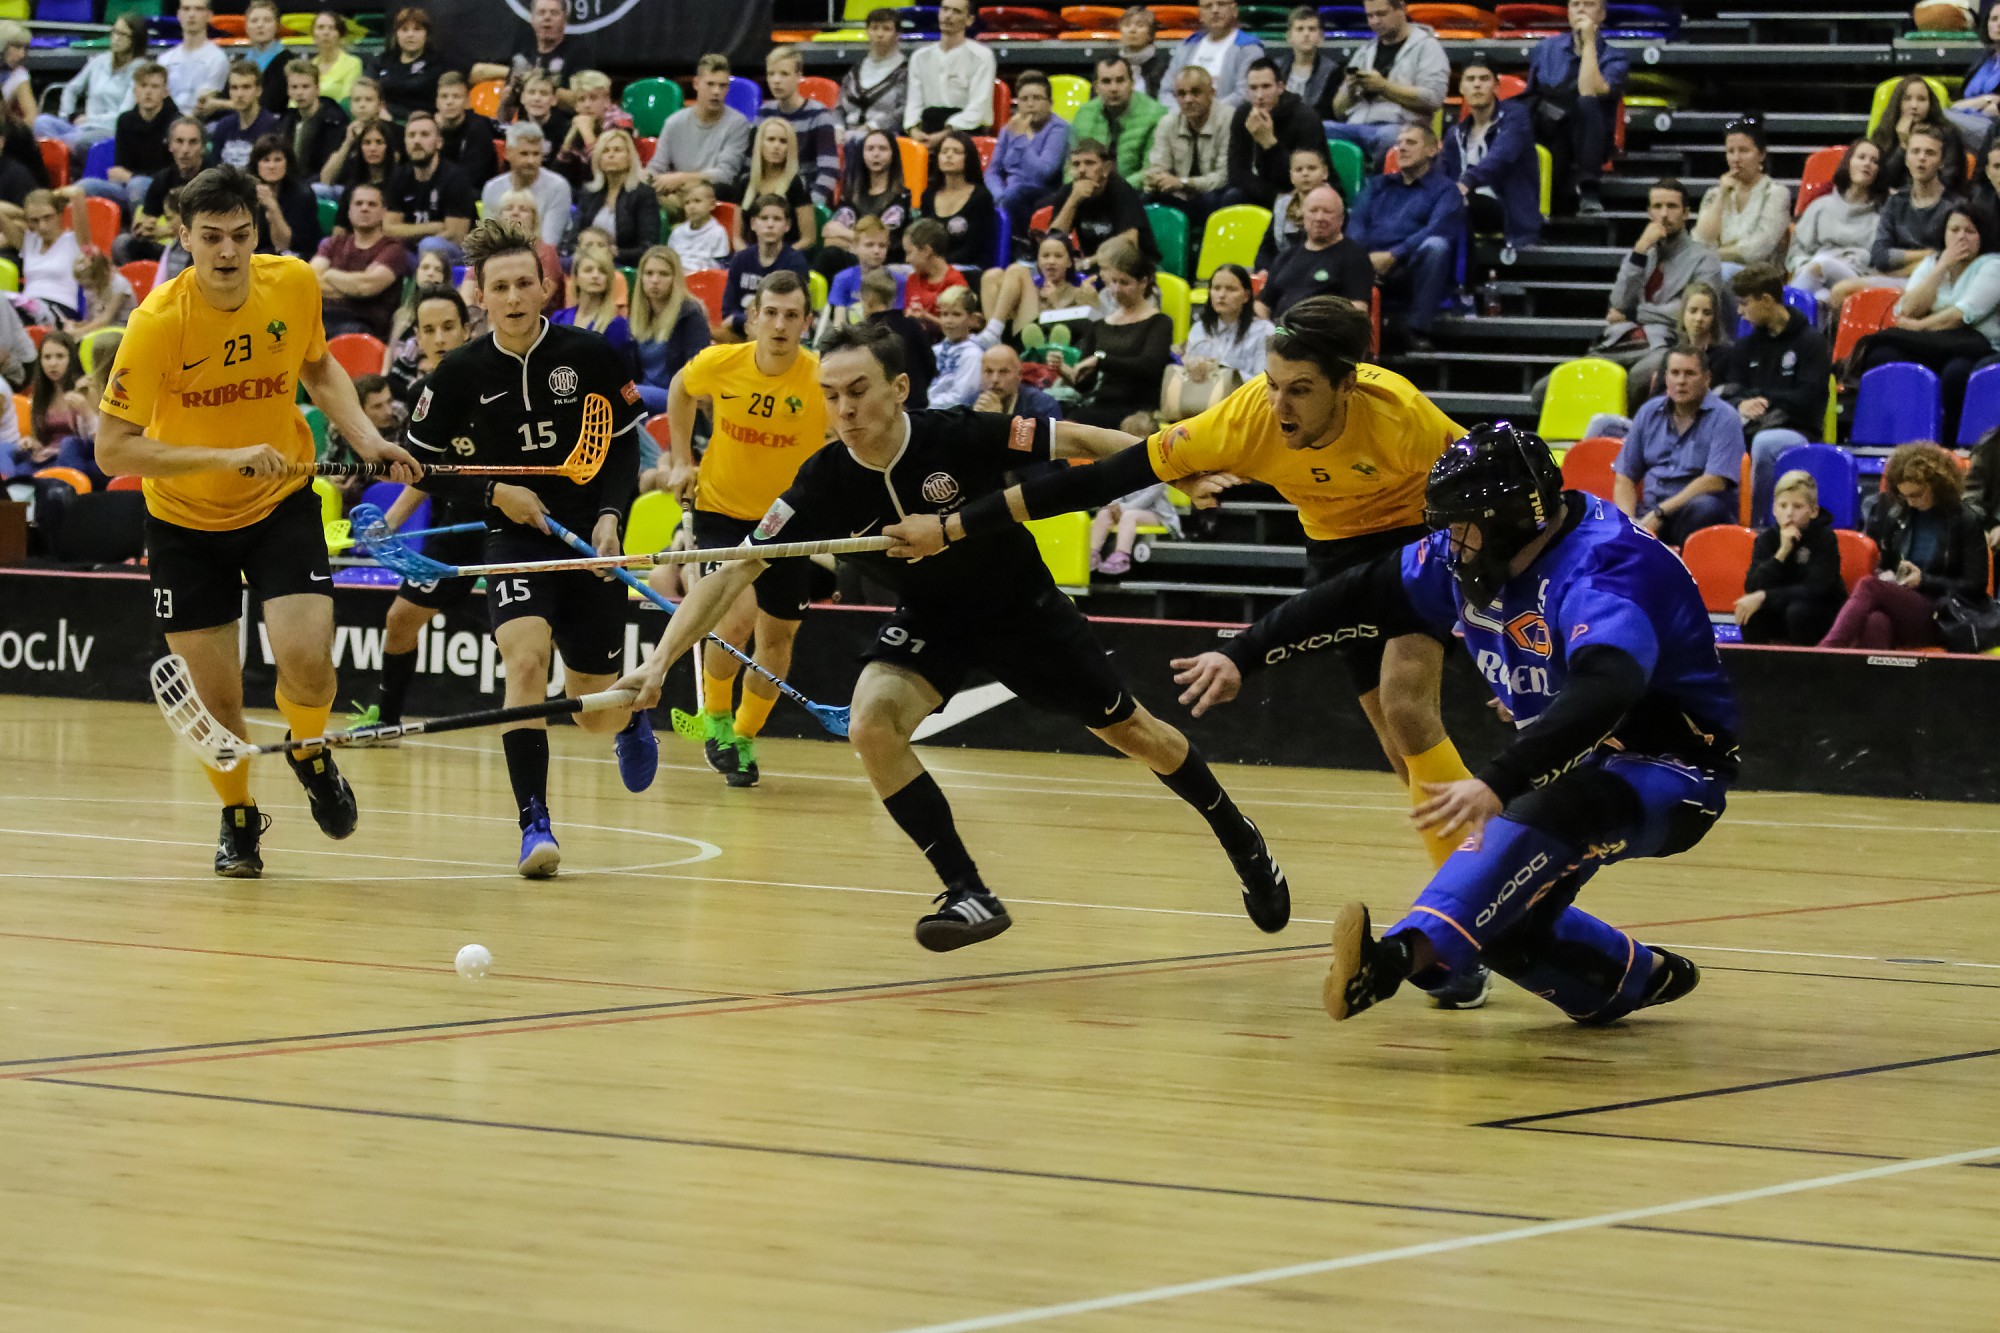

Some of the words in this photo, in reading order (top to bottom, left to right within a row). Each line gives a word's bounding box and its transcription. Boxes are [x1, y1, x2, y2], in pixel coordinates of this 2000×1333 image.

[223, 334, 252, 367] 23
[181, 371, 289, 409] RUBENE
[748, 393, 775, 418] 29
[518, 421, 557, 451] 15
[721, 417, 801, 449] RUBENE
[1311, 467, 1331, 483] 5
[153, 588, 174, 618] 23
[495, 578, 532, 608] 15
[0, 618, 95, 672] oc.lv
[880, 626, 926, 654] 91
